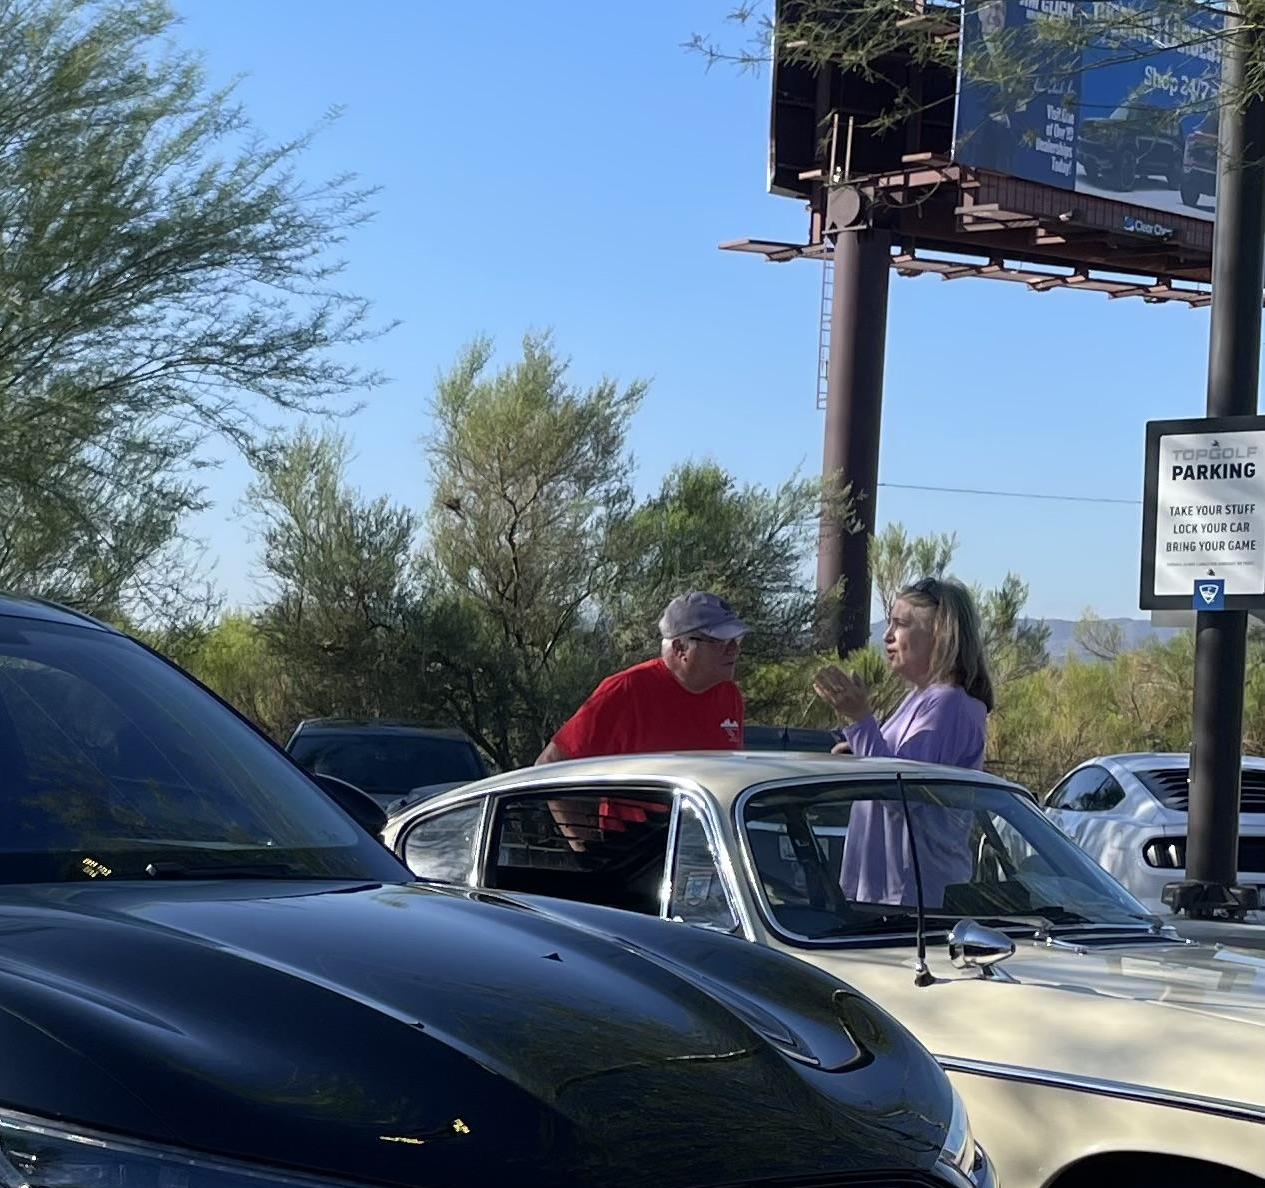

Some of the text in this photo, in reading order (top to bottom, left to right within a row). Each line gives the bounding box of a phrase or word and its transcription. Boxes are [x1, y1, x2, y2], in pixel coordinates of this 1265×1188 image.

[1145, 66, 1178, 96] Shop
[1172, 447, 1258, 461] TOPGOLF
[1172, 462, 1256, 481] PARKING
[1169, 503, 1256, 517] TAKE YOUR STUFF
[1173, 522, 1250, 534] LOCK YOUR CAR
[1166, 539, 1256, 552] BRING YOUR GAME
